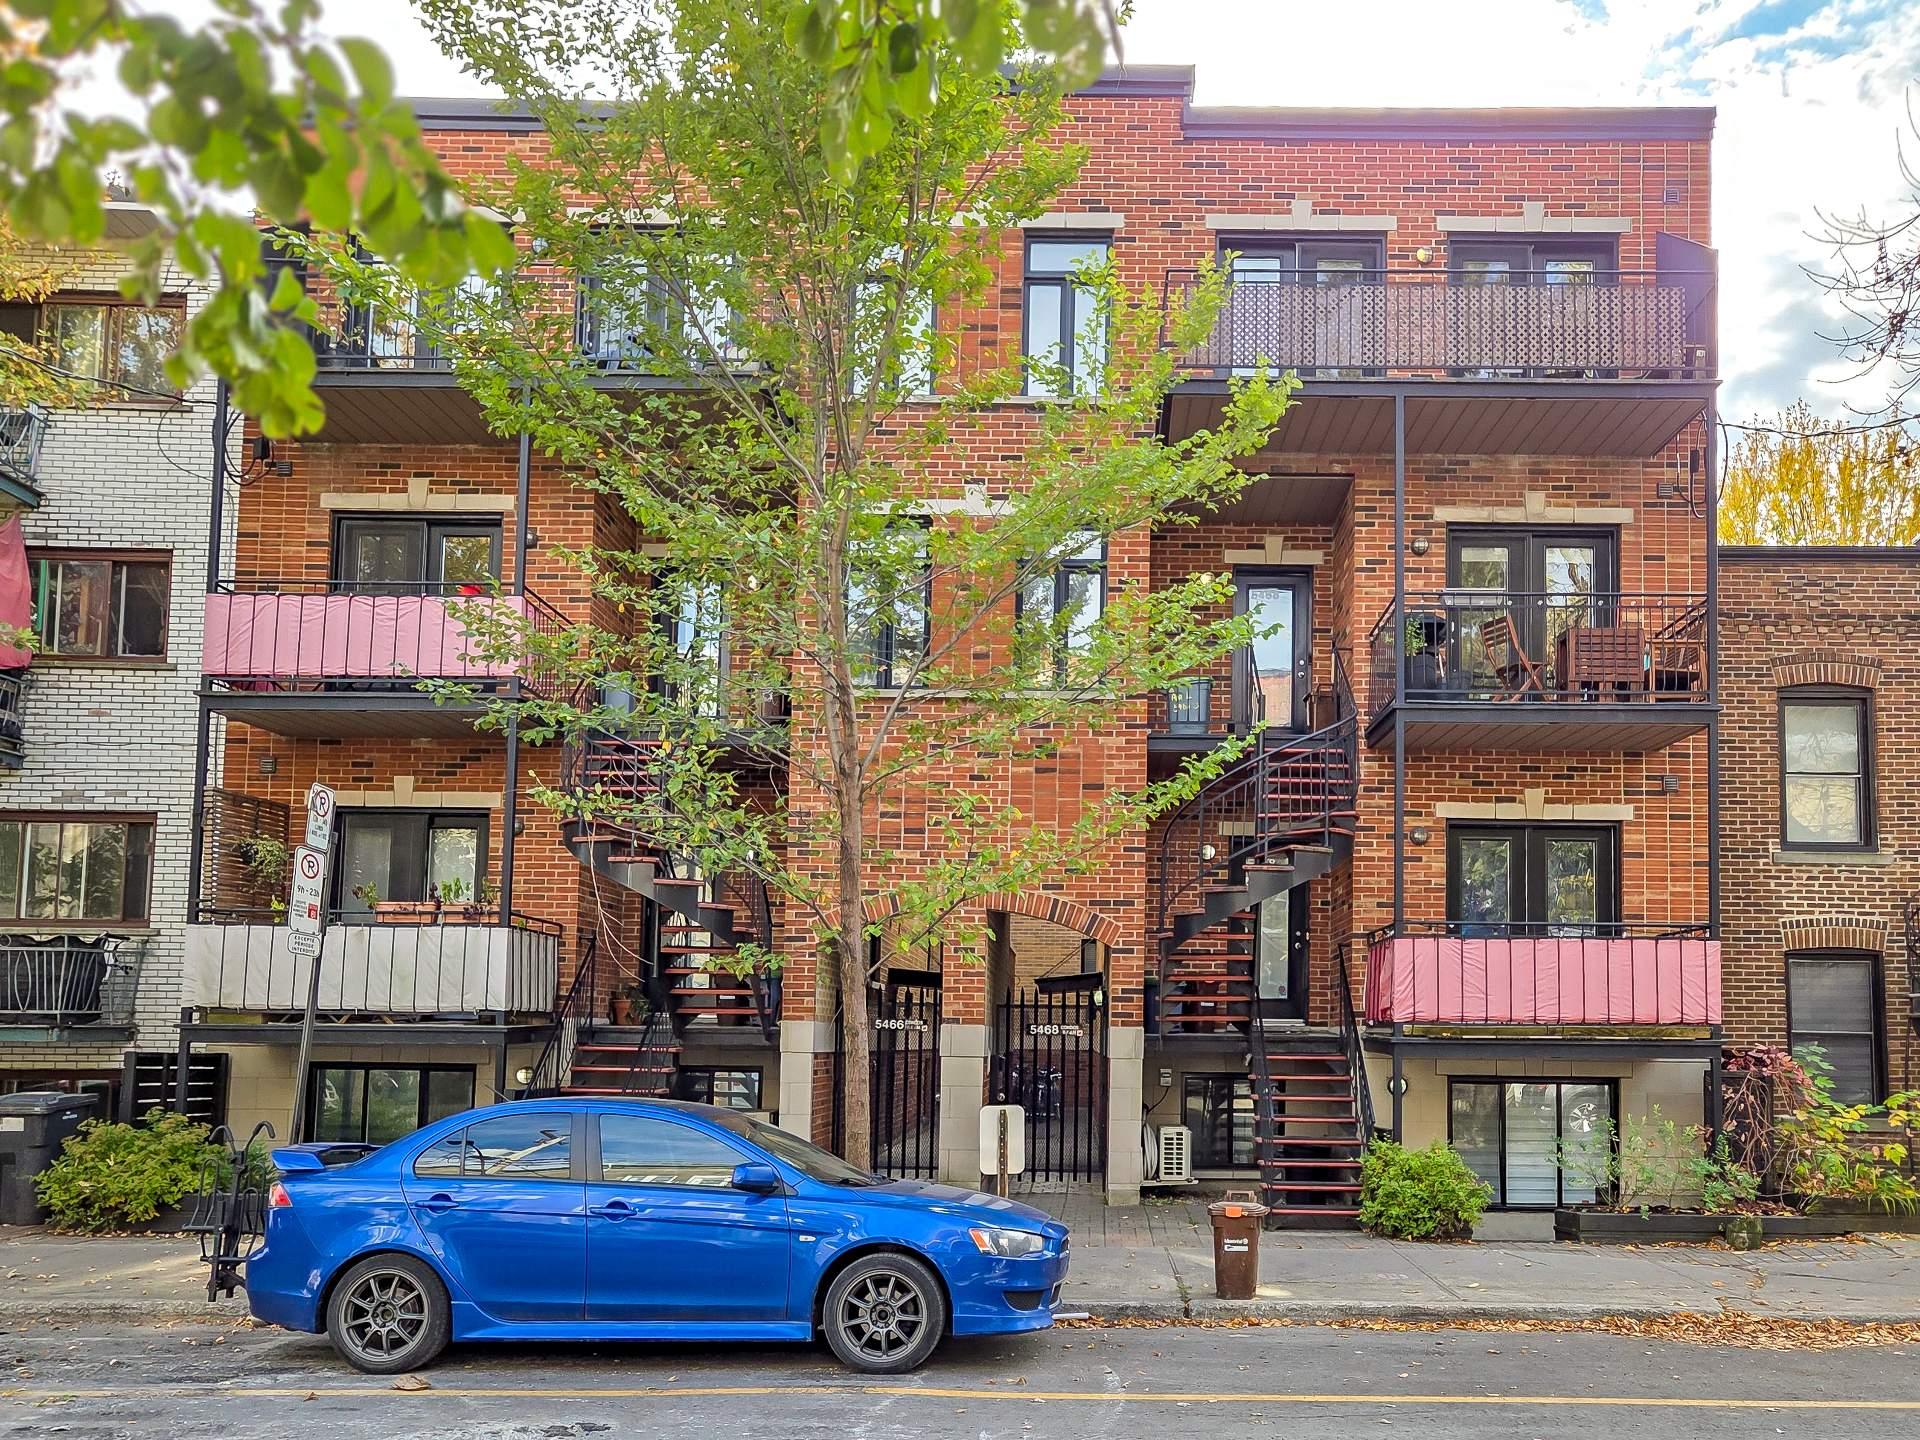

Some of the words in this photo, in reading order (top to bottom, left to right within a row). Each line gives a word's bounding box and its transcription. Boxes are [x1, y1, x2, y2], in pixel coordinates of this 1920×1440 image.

[297, 884, 305, 894] 9h
[875, 1019, 905, 1030] 5466
[1030, 1024, 1060, 1035] 5468
